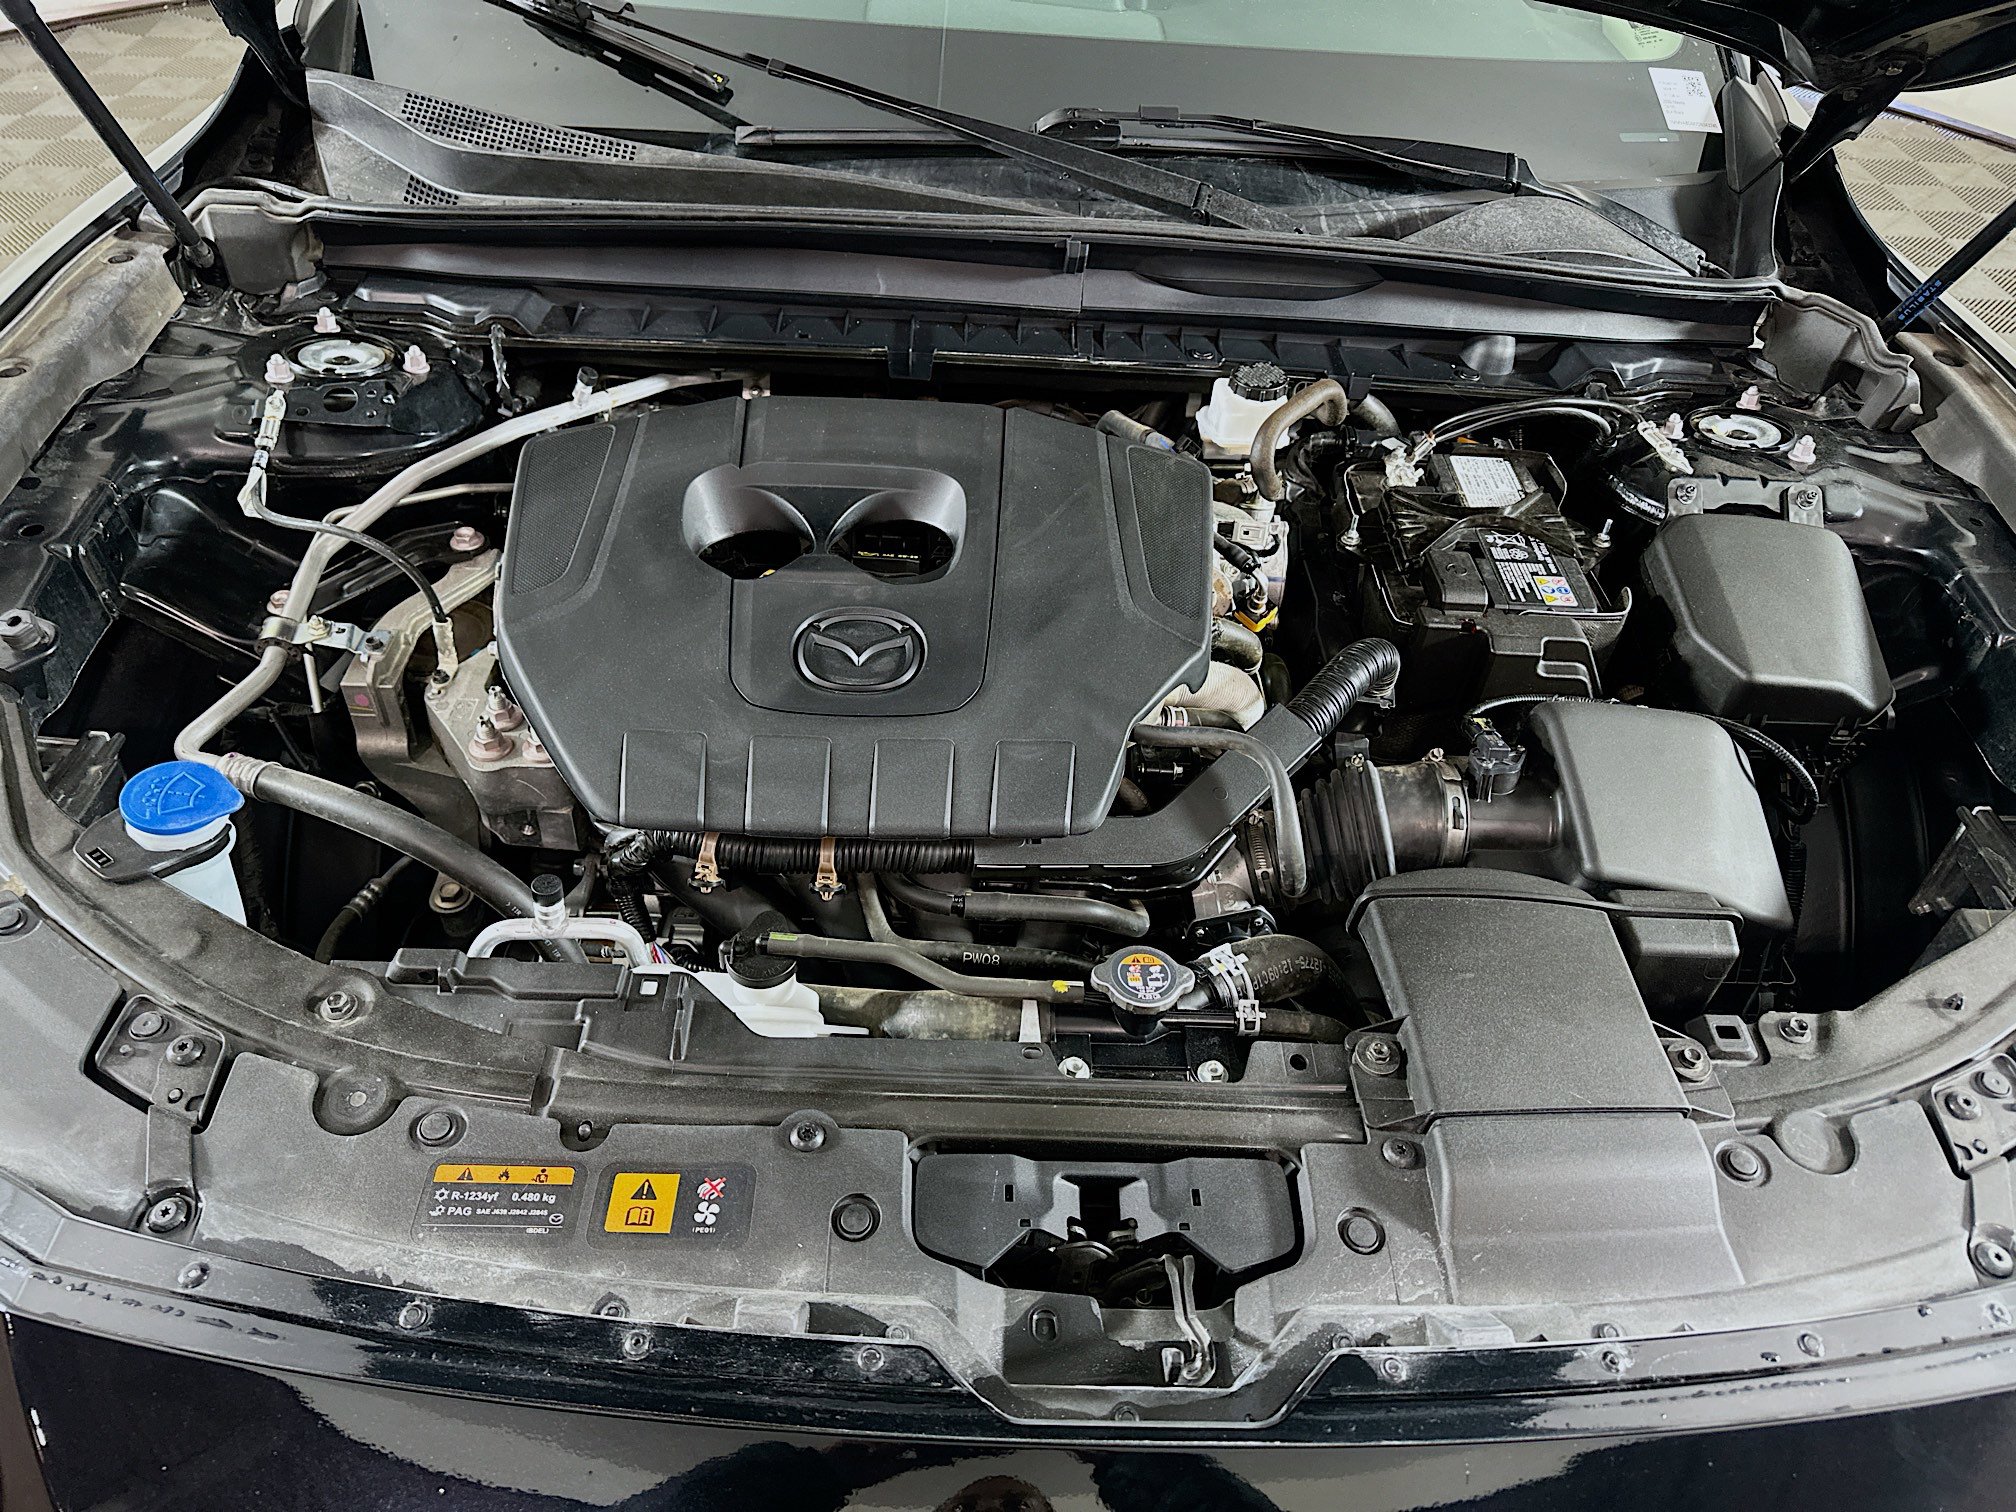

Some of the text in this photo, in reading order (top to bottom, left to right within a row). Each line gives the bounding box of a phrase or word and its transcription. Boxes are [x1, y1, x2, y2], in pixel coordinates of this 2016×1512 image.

[1898, 280, 1942, 320] STABILUS
[963, 951, 1000, 965] PW08
[451, 1191, 556, 1204] R-1234yf 0.480 kg
[446, 1206, 472, 1216] PAG
